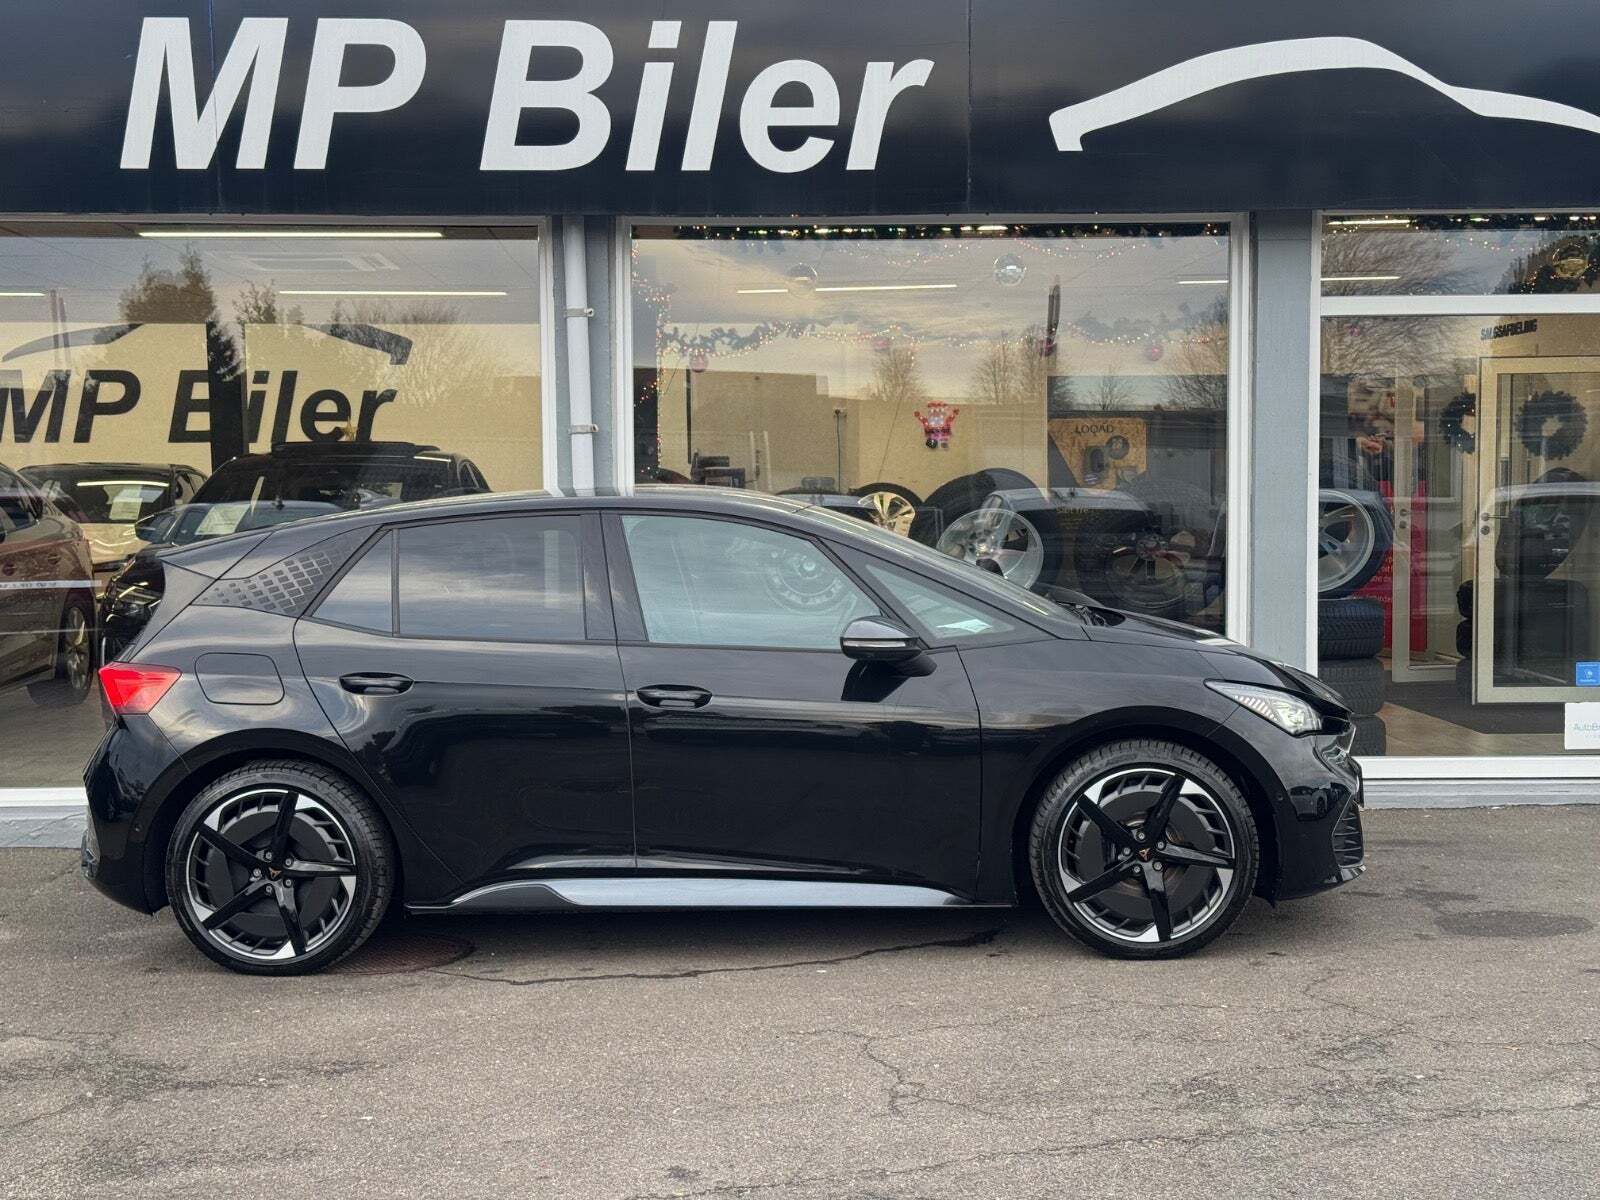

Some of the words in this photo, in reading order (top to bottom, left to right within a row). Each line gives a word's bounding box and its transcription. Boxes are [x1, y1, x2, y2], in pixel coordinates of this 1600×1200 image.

[120, 17, 426, 170] MP
[480, 20, 934, 172] Biler
[0, 369, 141, 443] MP
[168, 370, 398, 443] Biler
